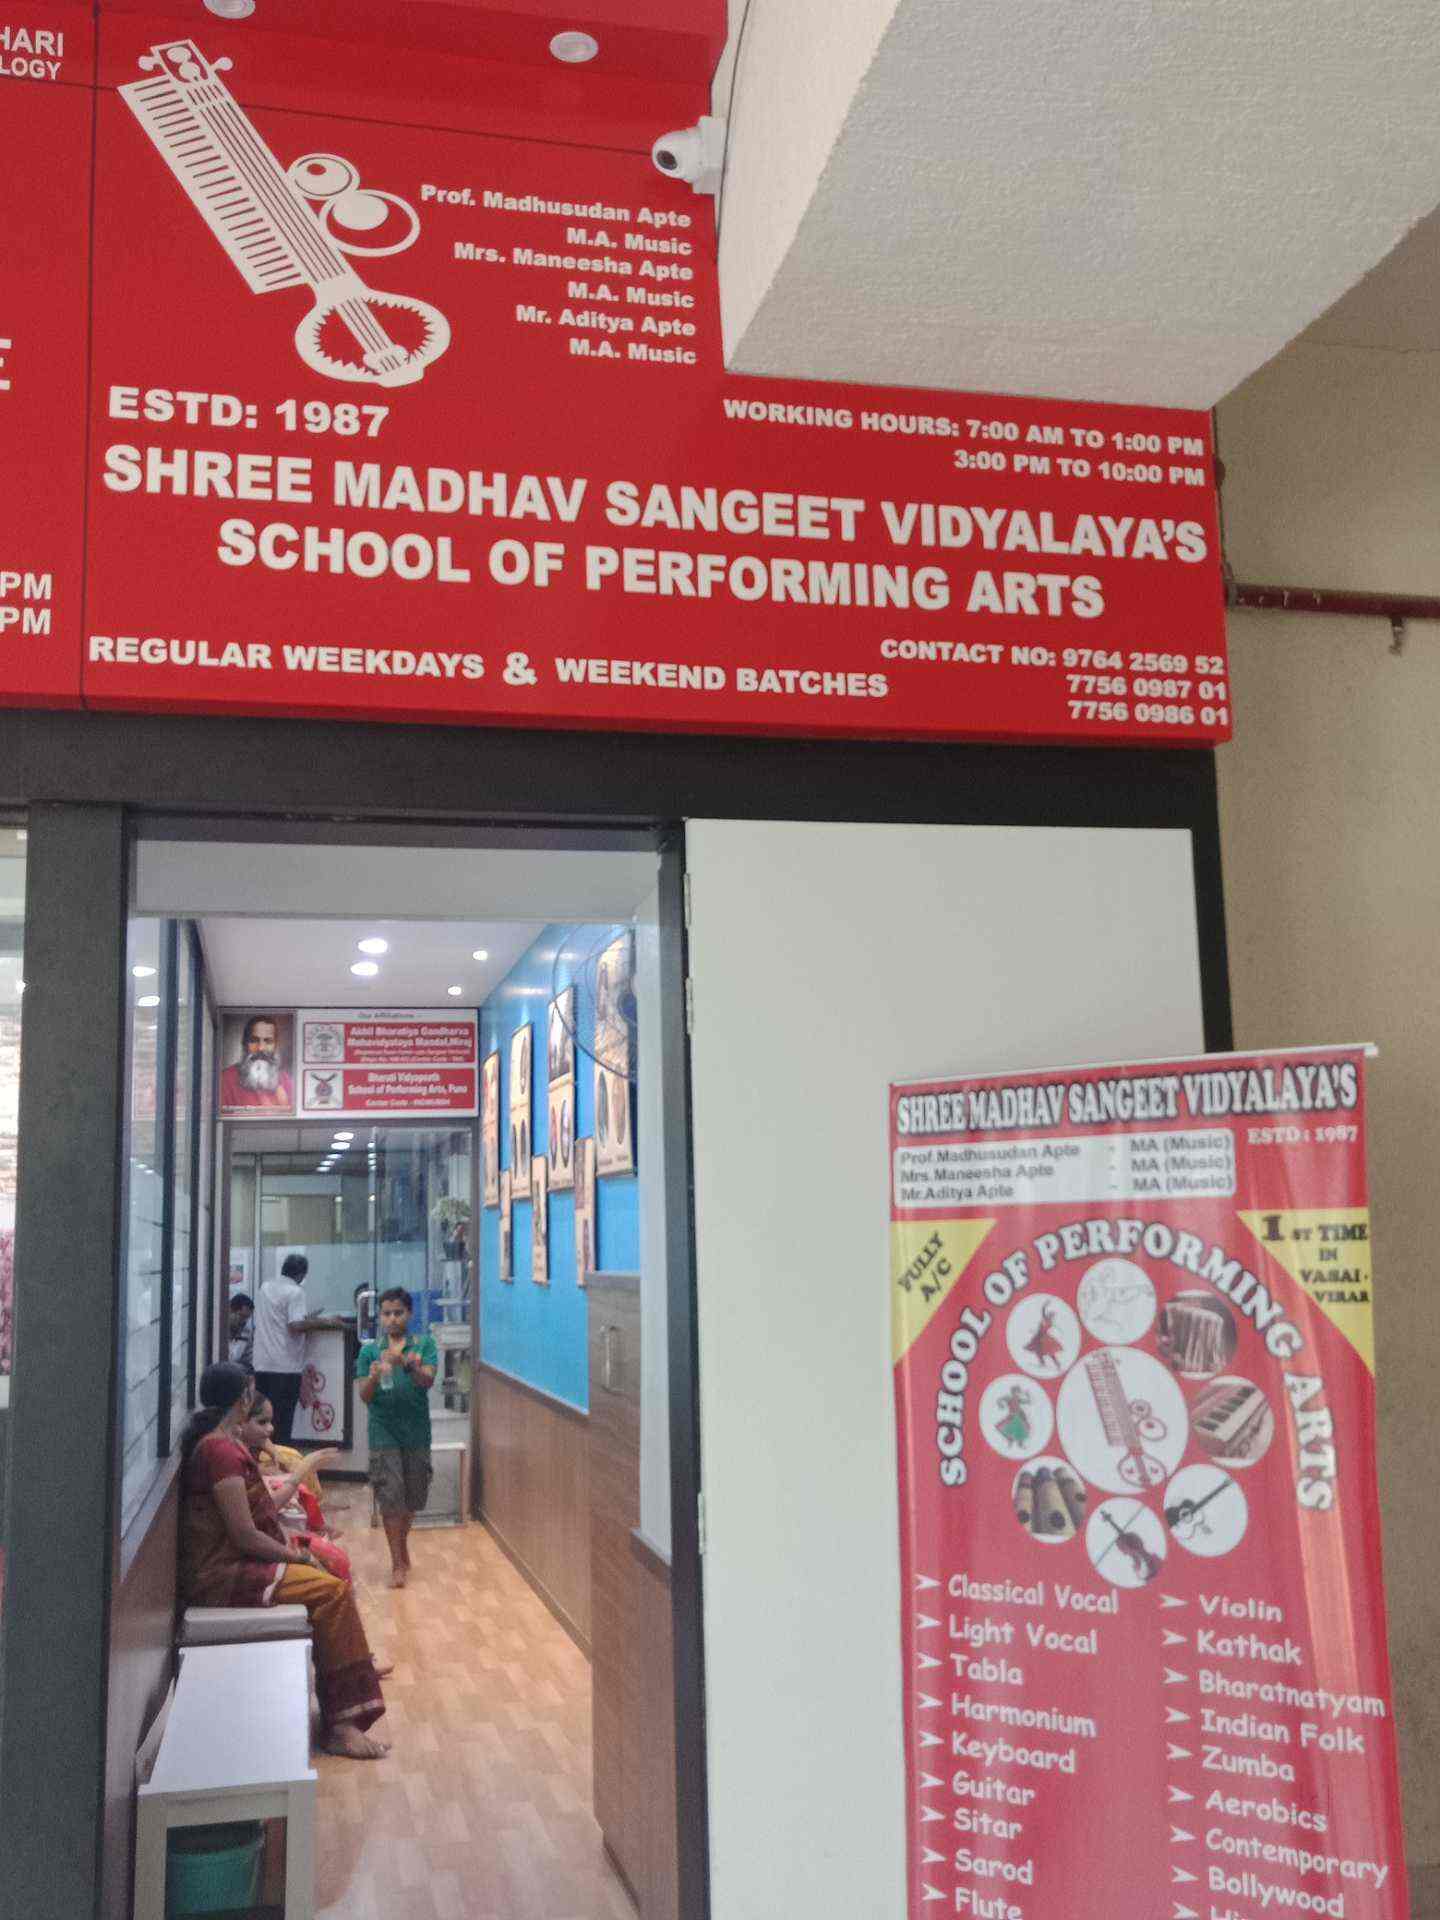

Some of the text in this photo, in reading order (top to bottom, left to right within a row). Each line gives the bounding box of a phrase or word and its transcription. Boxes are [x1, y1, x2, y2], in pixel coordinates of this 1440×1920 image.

[421, 184, 692, 228] Prof. Madhusudan Apte
[567, 227, 692, 255] M.A. Music
[454, 242, 693, 281] Mrs. Maneesha Apte
[568, 281, 694, 308] M.A. Music
[516, 305, 696, 337] Mr. Aditya Apte
[569, 338, 696, 364] M.A. Music
[108, 386, 389, 437] ESTD: 1987
[724, 399, 1204, 456] WORKING HOURS: 7:00 AM TO 1:00 PM
[954, 451, 1205, 486] 3:00 PM TO 10:00 PM
[103, 445, 1207, 563] SHREE MADHAV SANGEET VIDYALAYA'S
[0, 571, 52, 600] PM
[218, 519, 1104, 619] SCHOOL OF PERFORMING ARTS
[0, 606, 51, 635] PM
[89, 636, 888, 699] REGULAR WEEKDAYS & WEEKEND BATCHES
[880, 639, 1224, 675] CONTACT NO: 9764 2569 52
[1066, 674, 1227, 700] 7756 0987 01
[1068, 700, 1228, 725] 7756 0986 01
[897, 1062, 1358, 1135] SHREE MADHAV SANGEET VIDYALAYA'S
[1042, 1143, 1080, 1159] Apte
[1131, 1138, 1158, 1153] MA
[1163, 1134, 1231, 1152] (Music)
[1315, 1126, 1358, 1143] 1987
[1016, 1163, 1054, 1180] Apte
[1131, 1157, 1159, 1172] MA
[1165, 1155, 1231, 1172] (Music)
[977, 1185, 1014, 1199] Apte
[1133, 1176, 1160, 1191] MA
[1166, 1175, 1232, 1191] (Music)
[1317, 1223, 1368, 1242] TIME
[897, 1230, 945, 1293] FULLY
[1318, 1247, 1339, 1262] IN
[920, 1257, 953, 1304] A/C
[935, 1217, 1337, 1512] SCHOOL OF PERFORMING ARTS
[948, 1574, 1119, 1614] Classical Vocal
[1199, 1594, 1283, 1623] Violin
[949, 1615, 1098, 1655] Light Vocal
[1197, 1630, 1302, 1666] Kathak
[950, 1654, 1024, 1686] Tabla
[1198, 1669, 1386, 1717] Bharatnatyam
[951, 1693, 1097, 1738] Harmonium
[1201, 1709, 1365, 1754] Indian Folk
[952, 1731, 1076, 1774] Keyboard
[1201, 1746, 1296, 1783] Zumba
[952, 1771, 1036, 1806] Guitar
[953, 1808, 1023, 1840] Sitar
[1205, 1790, 1328, 1833] Aerobics
[955, 1848, 1033, 1885] Sarod
[1206, 1828, 1389, 1889] Contemporary
[955, 1887, 1022, 1920] Flute
[1208, 1868, 1345, 1919] Bollywood
